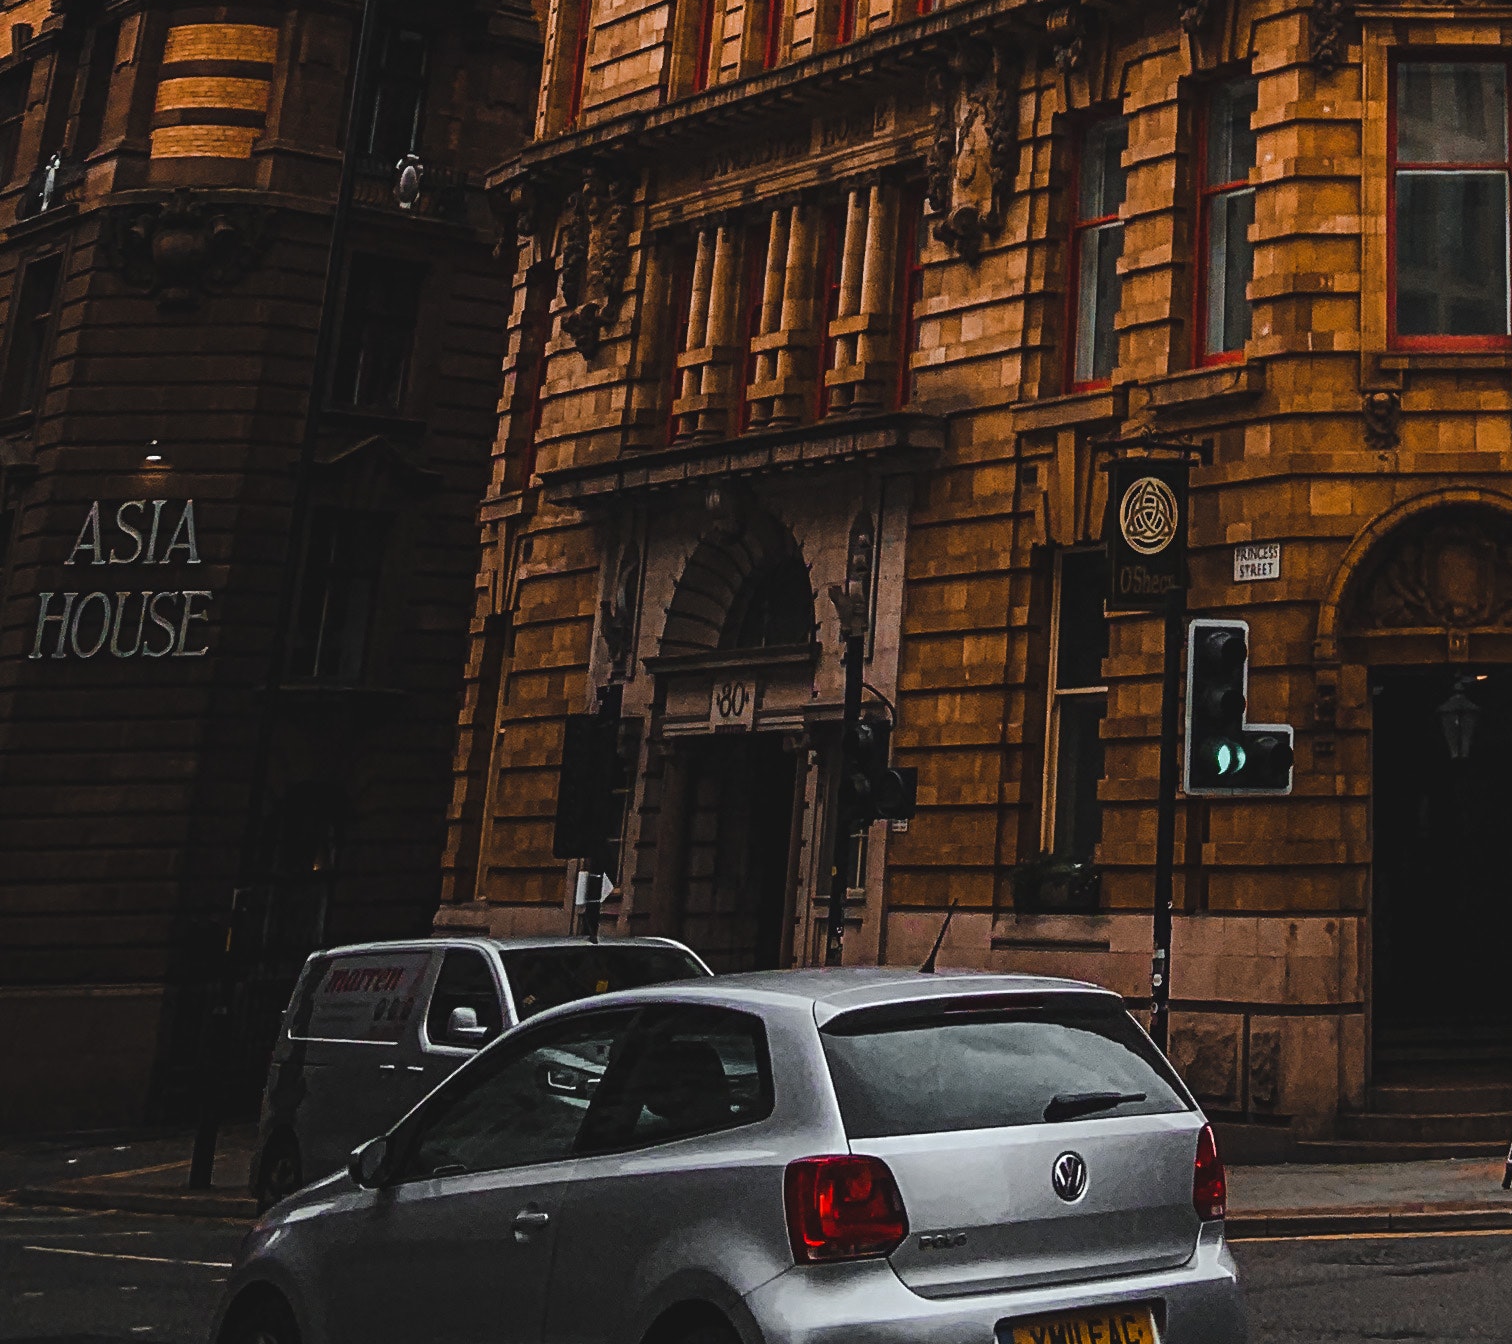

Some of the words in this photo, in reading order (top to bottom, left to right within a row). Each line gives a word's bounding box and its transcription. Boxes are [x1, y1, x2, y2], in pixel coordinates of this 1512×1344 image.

[64, 499, 202, 565] ASIA
[1235, 545, 1278, 562] PRINCESS
[1240, 562, 1274, 578] STREET
[28, 591, 213, 658] HOUSE
